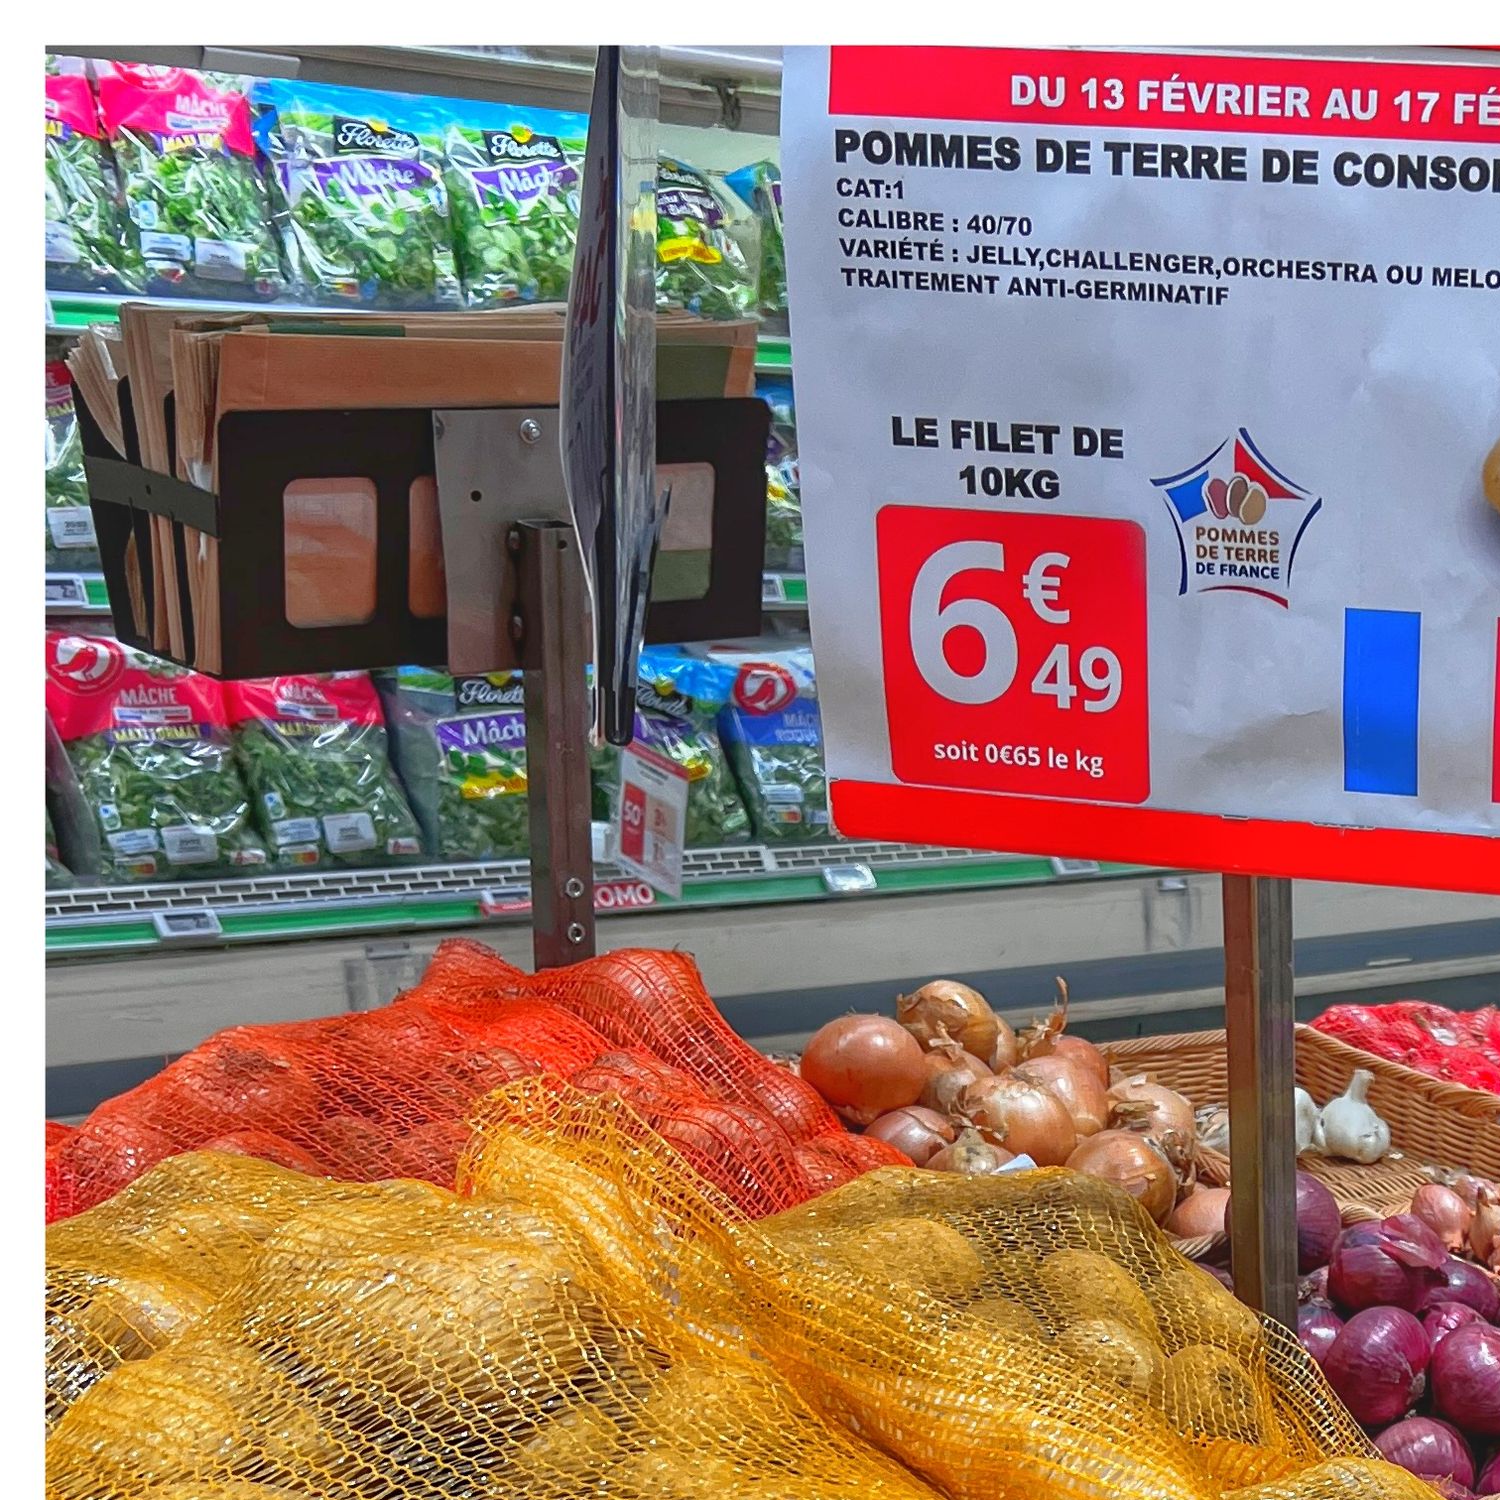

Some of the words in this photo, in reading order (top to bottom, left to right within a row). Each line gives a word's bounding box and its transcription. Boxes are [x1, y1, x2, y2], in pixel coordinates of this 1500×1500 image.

[1011, 74, 1066, 108] DU
[1081, 77, 1125, 110] 13
[1138, 73, 1310, 118] FÉVRIER
[1322, 88, 1378, 121] AU
[1393, 90, 1440, 123] 17
[337, 123, 420, 150] Florette
[490, 134, 561, 159] Florette
[835, 129, 1021, 172] POMMES
[1035, 138, 1091, 175] DE
[1103, 140, 1247, 181] TERRE
[1262, 148, 1319, 185] DE
[836, 178, 904, 200] CAT:1
[838, 208, 944, 232] CALIBRE
[952, 217, 959, 233] :
[967, 215, 1033, 236] 40/70
[839, 235, 945, 262] VARIÉTÉ
[952, 248, 959, 263] :
[1386, 264, 1423, 286] OU
[841, 268, 1000, 295] TRAITEMENT
[1007, 277, 1229, 306] ANTI-GERMINATIF
[891, 415, 939, 450] LE
[950, 419, 1060, 456] FILET
[1073, 426, 1124, 459] DE
[958, 465, 1060, 499] 10KG
[1195, 526, 1280, 547] POMMES
[1196, 544, 1218, 561] DE
[1223, 546, 1280, 564] TERRE
[1196, 561, 1216, 576] DE
[1219, 562, 1280, 580] FRANCE
[120, 684, 177, 706] MÂCHE
[459, 680, 524, 704] Florett
[463, 718, 526, 746] Mâch
[933, 741, 979, 763] soit
[984, 743, 1041, 767] 0€65
[1048, 748, 1068, 769] le
[1075, 749, 1105, 777] kg
[594, 882, 655, 908] OMO
